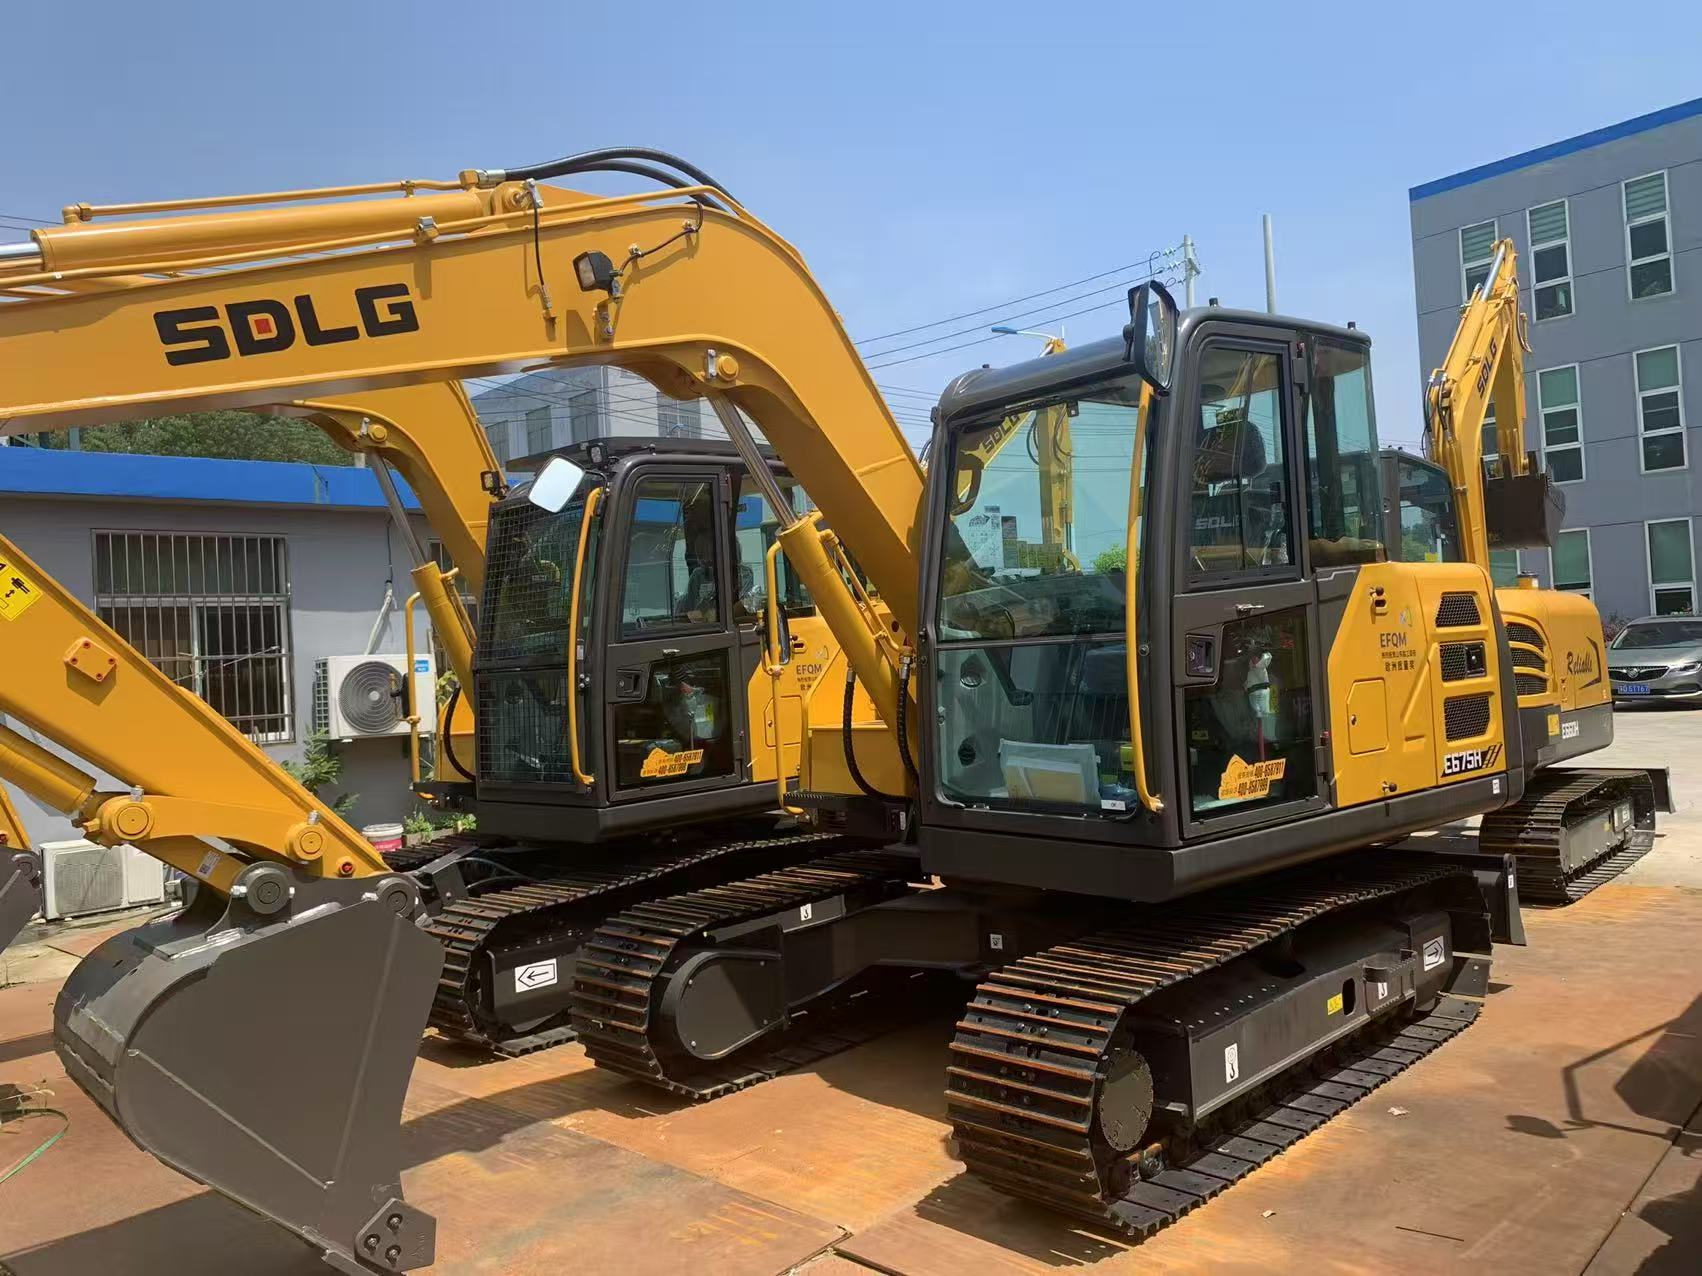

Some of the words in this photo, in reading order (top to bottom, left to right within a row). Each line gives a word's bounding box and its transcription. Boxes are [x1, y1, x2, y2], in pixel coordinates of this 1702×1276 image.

[153, 283, 419, 366] SDLG
[1477, 336, 1497, 399] SDLG
[1380, 632, 1407, 648] EFQM
[796, 664, 822, 675] EFQM
[1444, 749, 1482, 774] E675H
